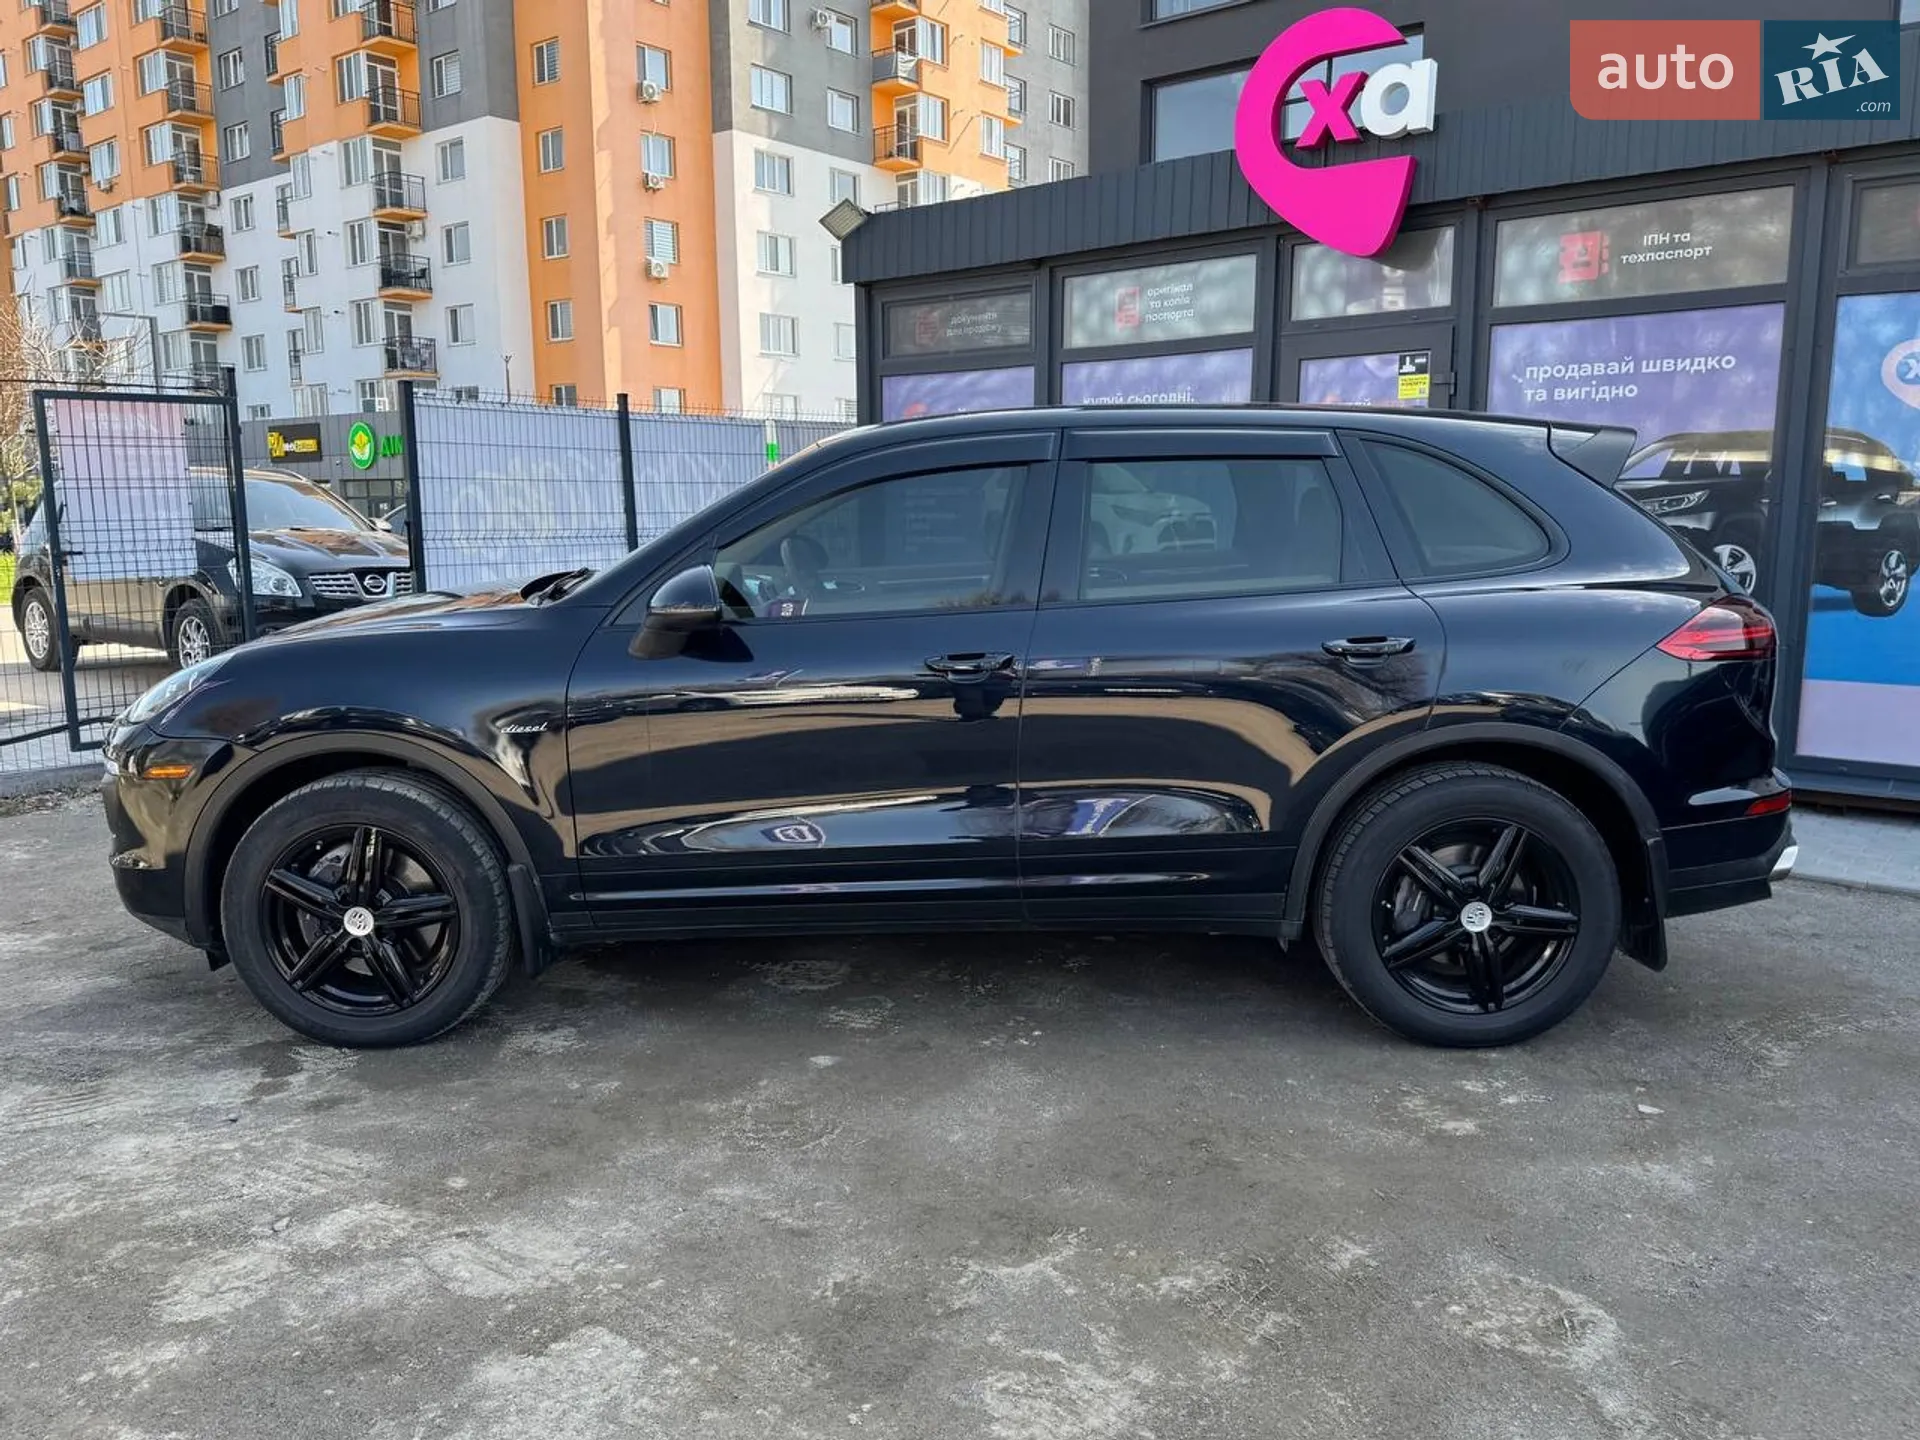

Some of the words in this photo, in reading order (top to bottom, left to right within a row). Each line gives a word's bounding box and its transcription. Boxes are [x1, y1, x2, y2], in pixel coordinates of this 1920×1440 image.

[1673, 232, 1691, 243] та
[1620, 245, 1713, 265] техпаспорт
[1525, 356, 1635, 383] продавай
[1640, 354, 1737, 374] швидко
[1524, 388, 1548, 402] та
[1553, 380, 1639, 402] вигідно
